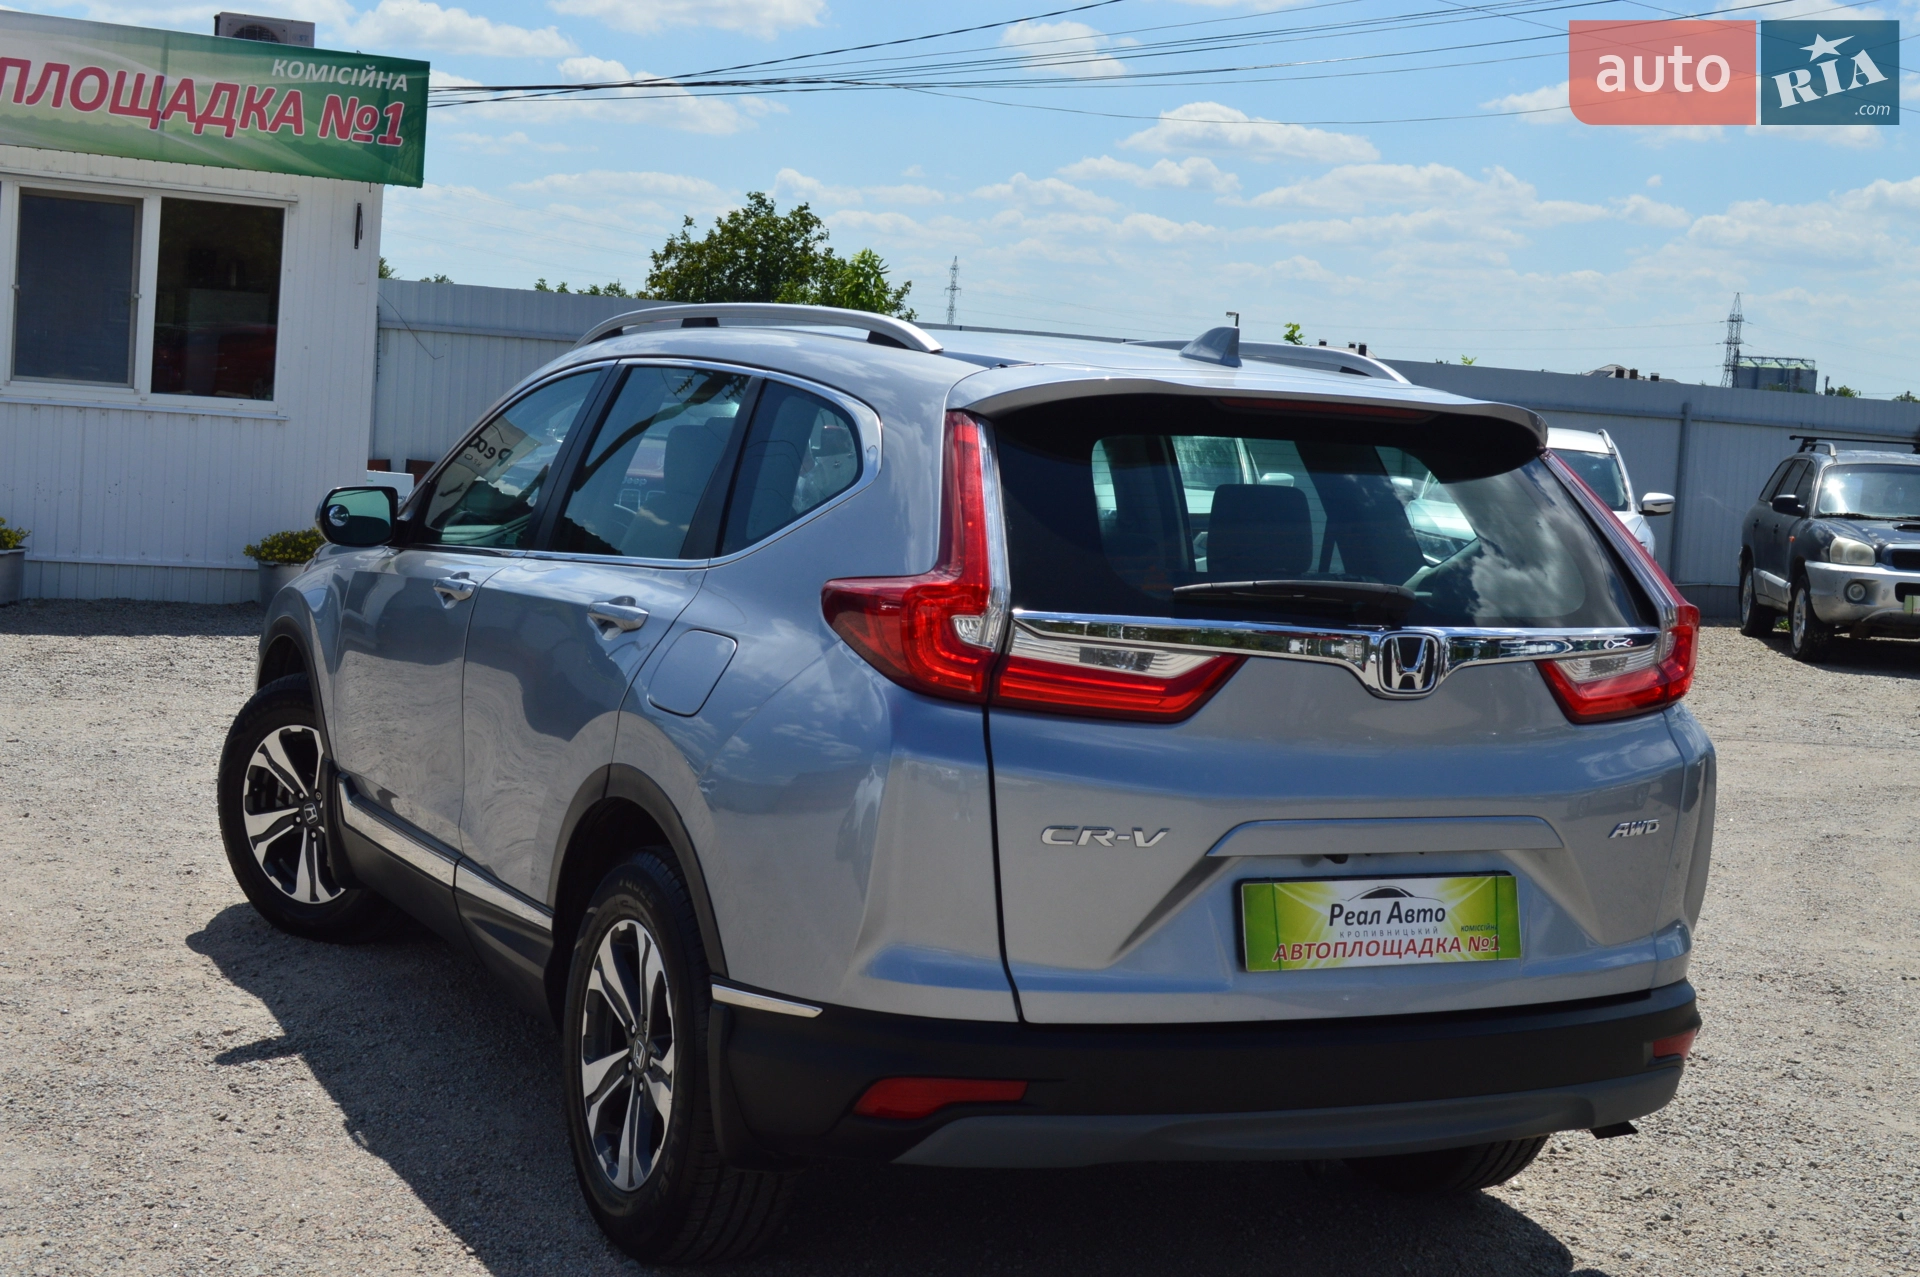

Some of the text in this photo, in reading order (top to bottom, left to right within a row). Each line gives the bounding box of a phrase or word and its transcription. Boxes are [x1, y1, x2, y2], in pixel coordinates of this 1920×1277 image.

[272, 59, 408, 92] КОМІСІЙНА
[0, 57, 405, 147] ПЛОЩАДКА №1
[1041, 825, 1171, 848] CR-V
[1608, 818, 1660, 839] AWD
[1329, 901, 1446, 927] Реал Авто
[1339, 926, 1439, 939] КРОПИВНИЦЬКИЙ
[1272, 934, 1500, 961] АВТОПЛОЩАДКА №1
